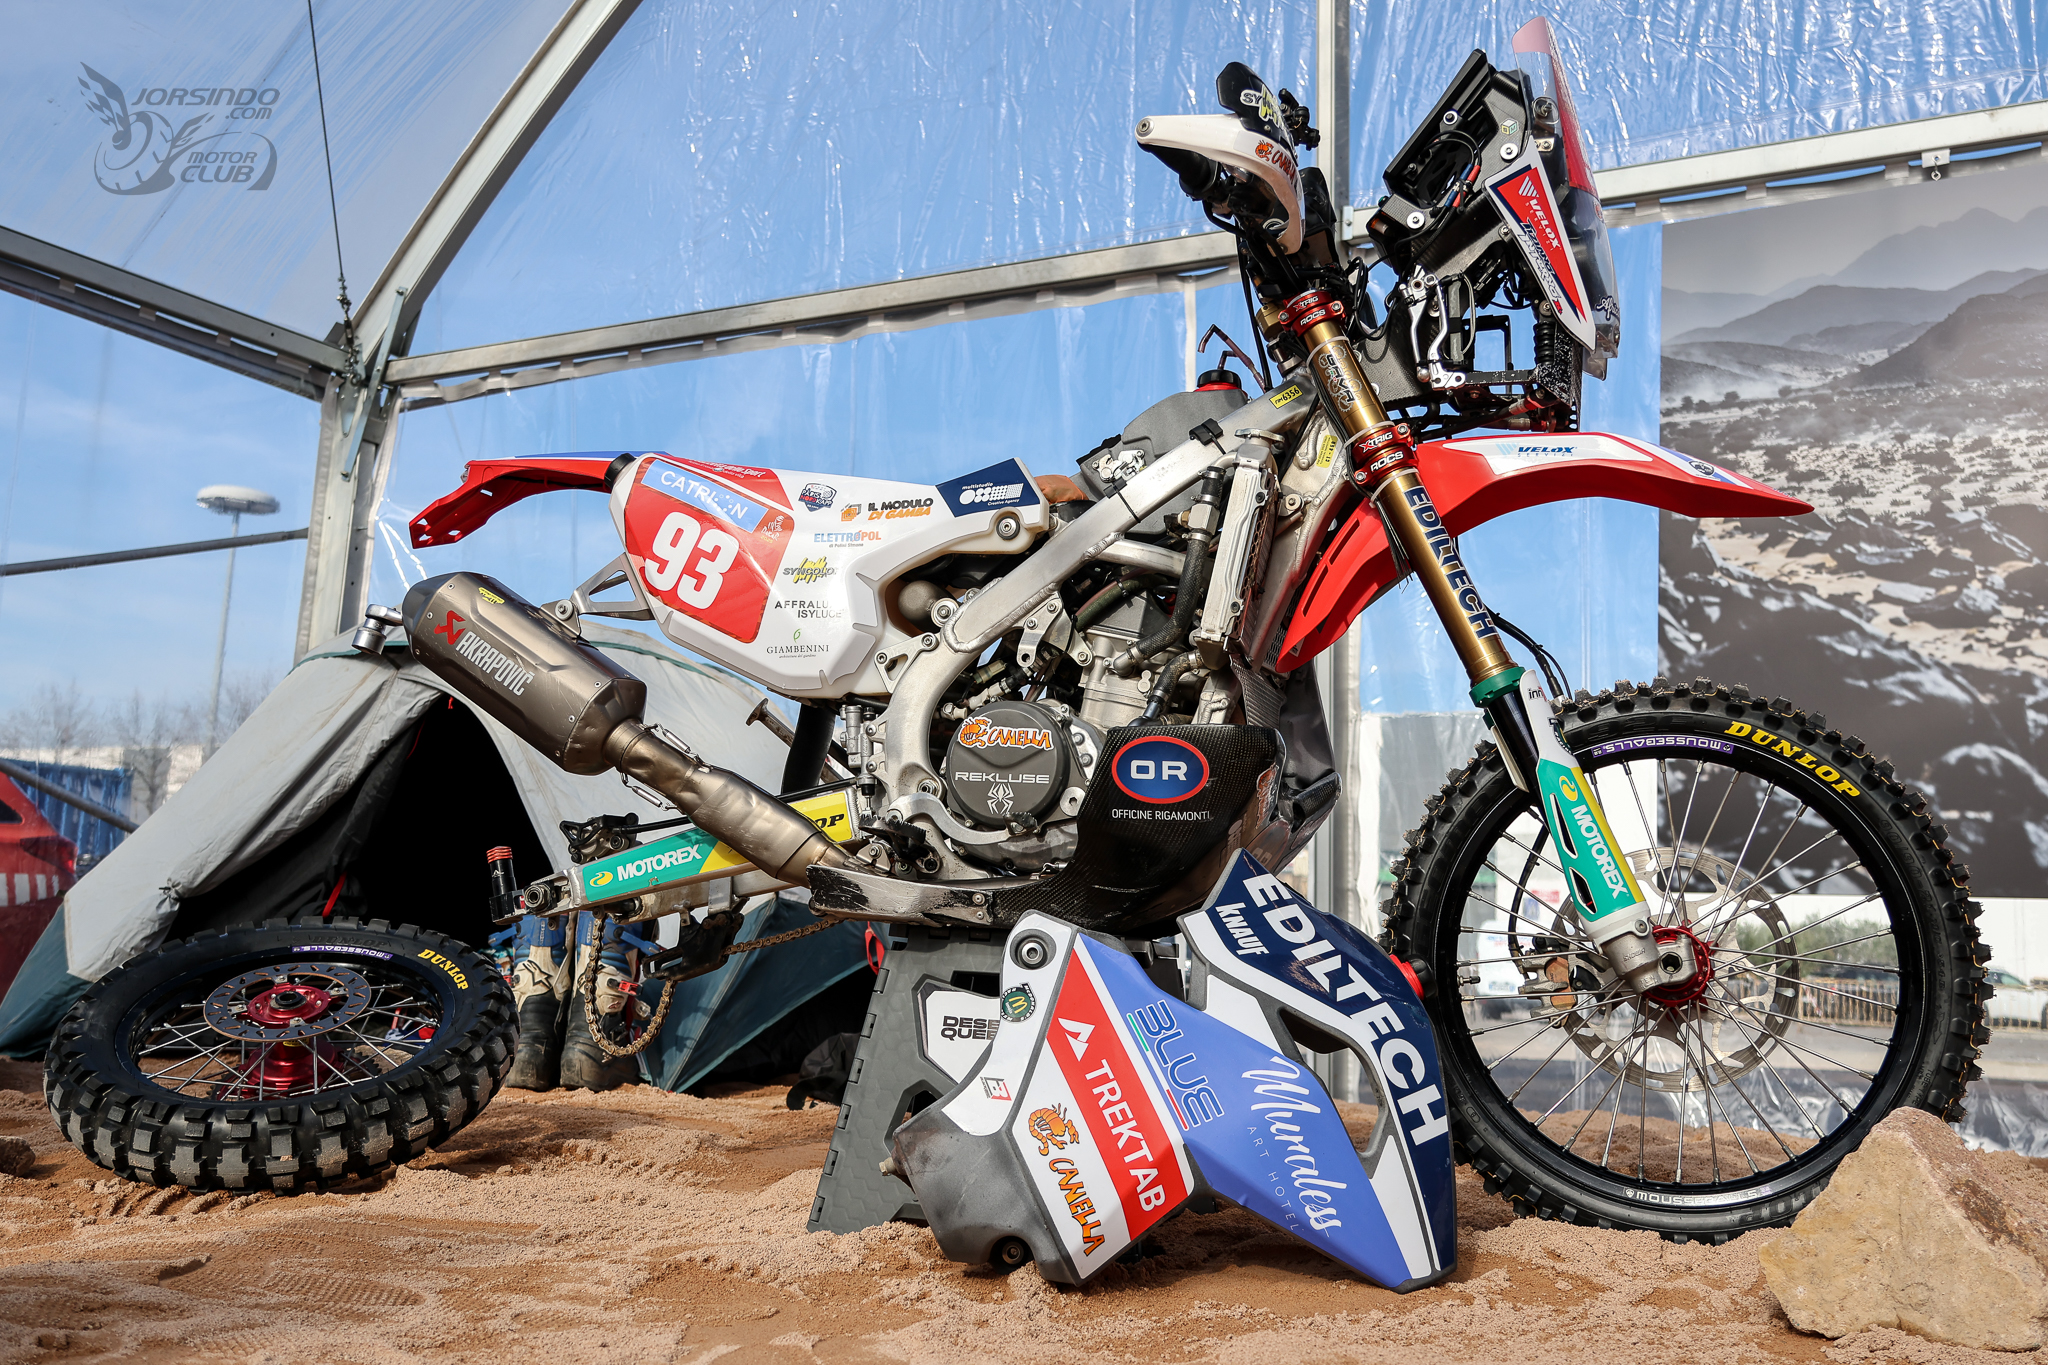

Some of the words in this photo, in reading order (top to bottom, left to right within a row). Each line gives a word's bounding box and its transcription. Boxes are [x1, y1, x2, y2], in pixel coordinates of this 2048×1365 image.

[1529, 198, 1561, 249] VELOX
[1293, 295, 1319, 312] XTRIG
[1300, 309, 1326, 326] ROCS
[1359, 431, 1394, 452] XTRIG
[1518, 446, 1575, 454] VELOX
[1370, 451, 1404, 472] ROCS
[868, 502, 879, 512] IL
[881, 497, 934, 511] MODULO
[868, 510, 884, 520] DI
[885, 506, 931, 519] GAMBA
[644, 511, 740, 610] 93
[783, 566, 838, 577] SYNCOLO
[1403, 485, 1498, 640] EDILTECH
[775, 600, 832, 609] AFFRALU
[766, 644, 829, 654] GIAMBENINI
[986, 725, 1053, 750] CANELLA
[1724, 720, 1861, 797] DUNLOP
[954, 771, 1050, 784] REKLUSE
[1111, 808, 1153, 820] OFFICINE
[1155, 809, 1211, 821] RIGAMONTI
[617, 844, 703, 882] MOTOREX
[1571, 804, 1629, 900] MOTOREX
[1215, 901, 1268, 957] KNAUF
[417, 949, 469, 991] DUNLOP
[1242, 873, 1450, 1147] EDILTECH
[942, 1015, 1000, 1029] DESE
[940, 1028, 998, 1041] QUEE
[1136, 999, 1224, 1128] BLUE
[1085, 1057, 1166, 1213] TREKTAB
[1247, 1125, 1269, 1159] ART
[1268, 1170, 1299, 1233] HOTEL
[1048, 1157, 1106, 1257] CANELLA
